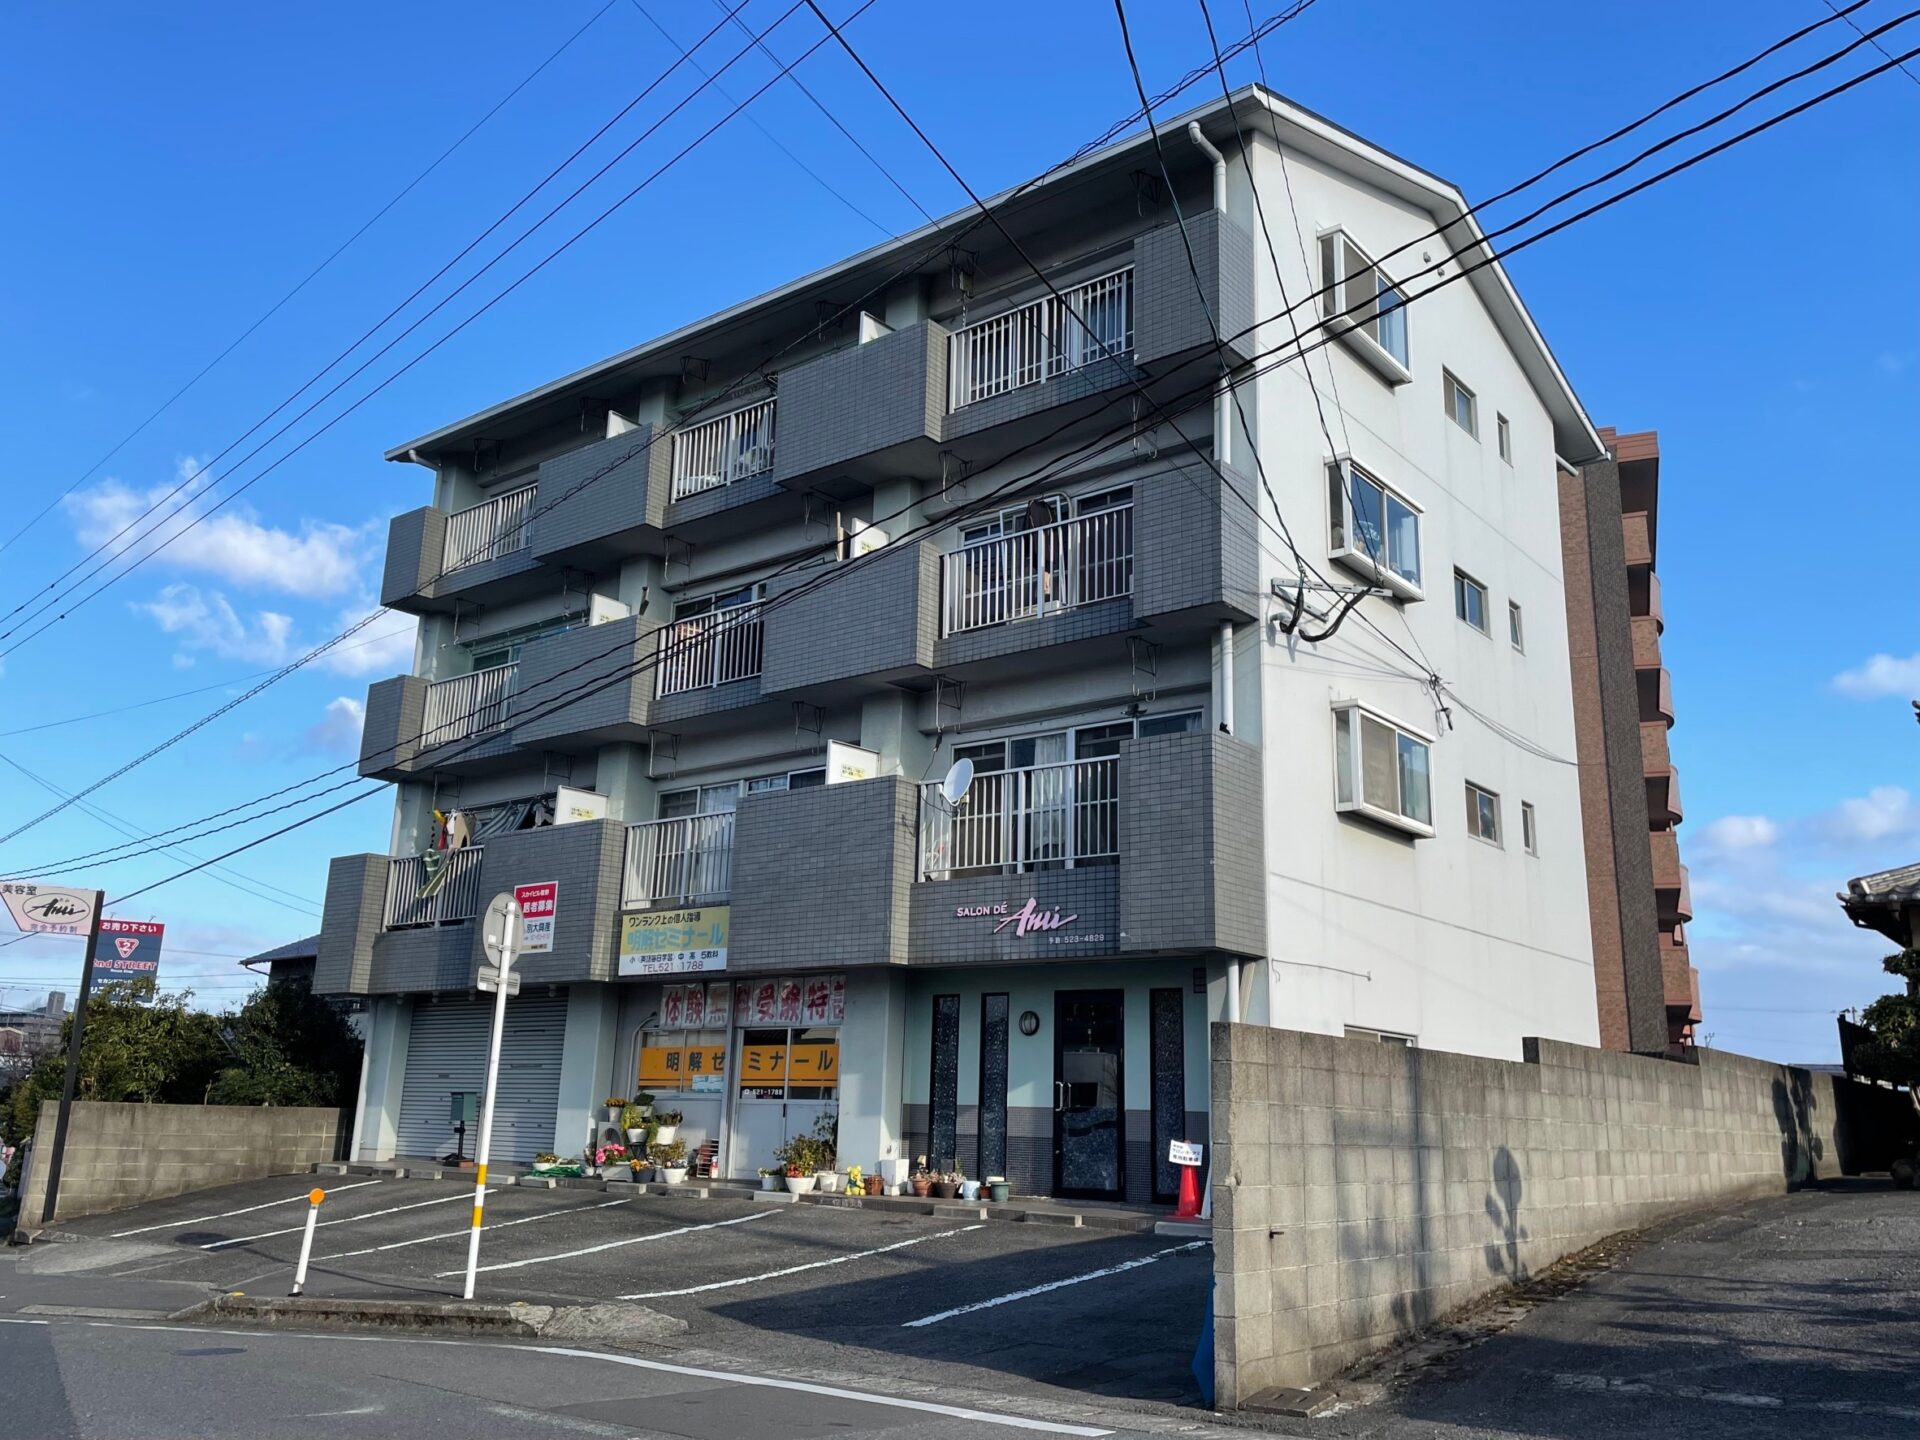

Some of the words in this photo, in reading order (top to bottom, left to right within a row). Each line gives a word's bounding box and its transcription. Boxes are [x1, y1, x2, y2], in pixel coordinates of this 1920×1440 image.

[2, 884, 38, 895] 美容室
[957, 906, 990, 917] SALON
[993, 901, 1008, 915] DÉ
[629, 911, 701, 928] ワンランク上の個人指導
[30, 923, 78, 933] 完全予約制
[102, 922, 157, 932] お売り下さい
[627, 923, 724, 951] 明解ゼミナール
[114, 960, 157, 971] STREET
[666, 1049, 834, 1072] 明解ゼミナール
